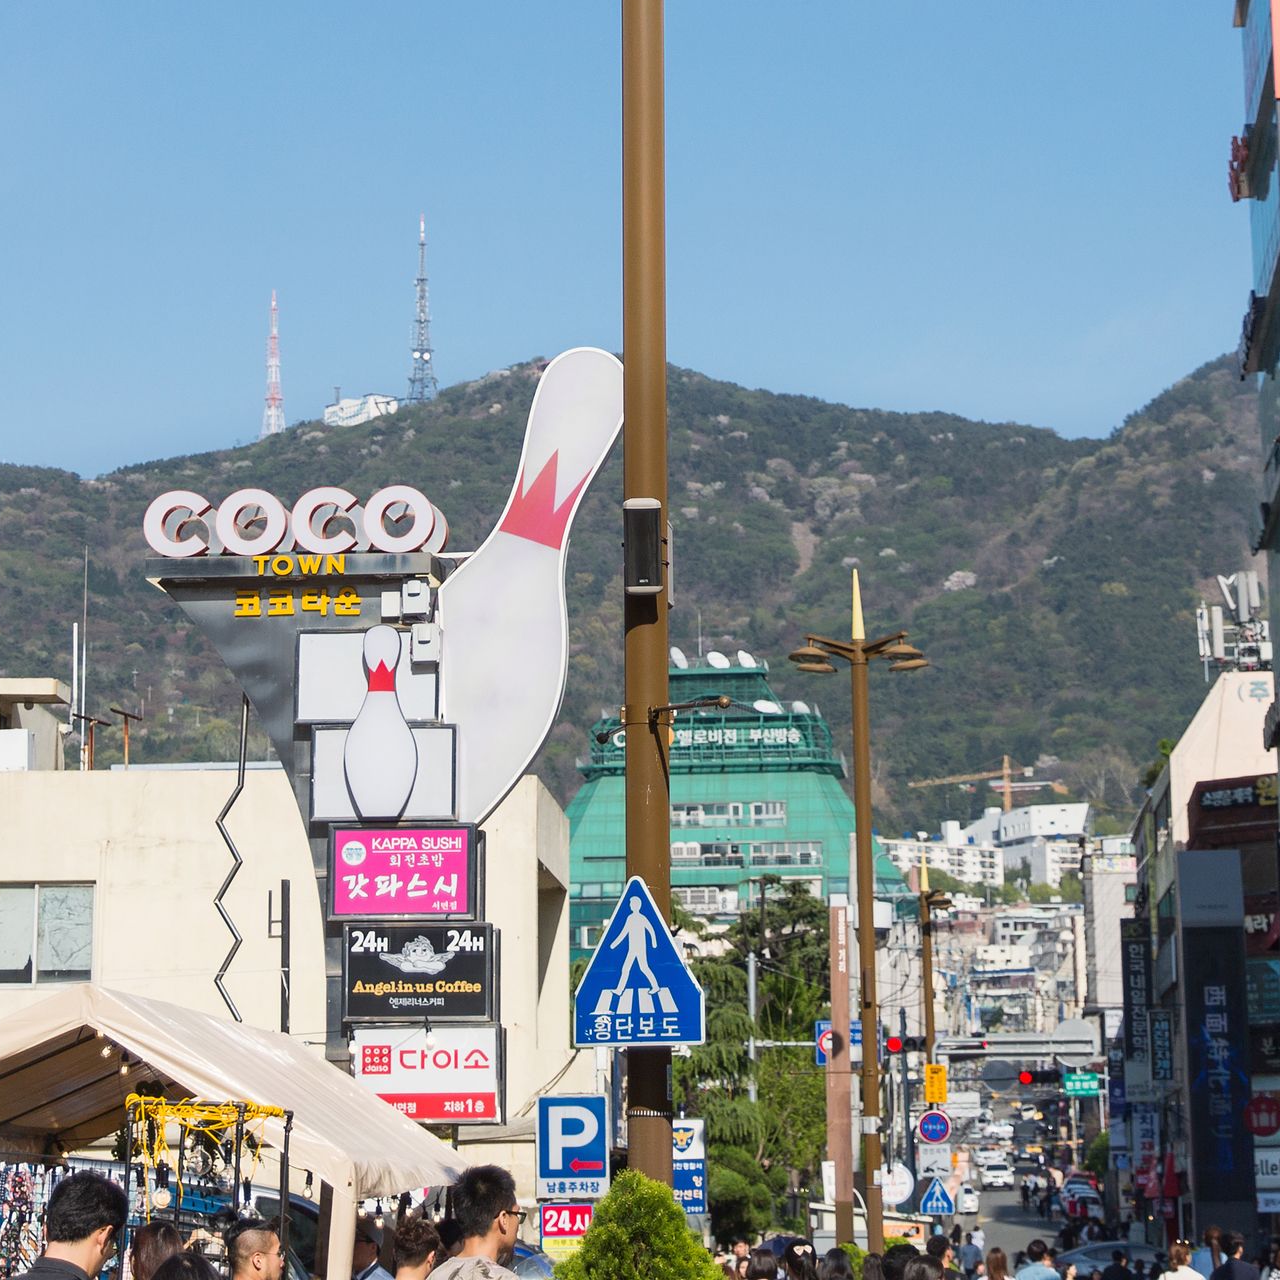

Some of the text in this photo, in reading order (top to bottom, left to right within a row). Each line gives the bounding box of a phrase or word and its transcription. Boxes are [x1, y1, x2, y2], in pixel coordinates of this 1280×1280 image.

[143, 485, 435, 557] COCO
[252, 554, 346, 576] TOWN
[234, 586, 361, 617] 코코타운
[372, 836, 462, 850] KAPPA SUSHI
[389, 853, 444, 868] 회전초밥
[342, 873, 458, 900] 갓파스시
[432, 901, 458, 911] 서면점
[351, 930, 484, 952] 24H 24H
[435, 980, 482, 994] Coffee
[593, 1015, 681, 1040] 횡단보도
[400, 1049, 489, 1070] 다이소
[548, 1106, 599, 1170] P
